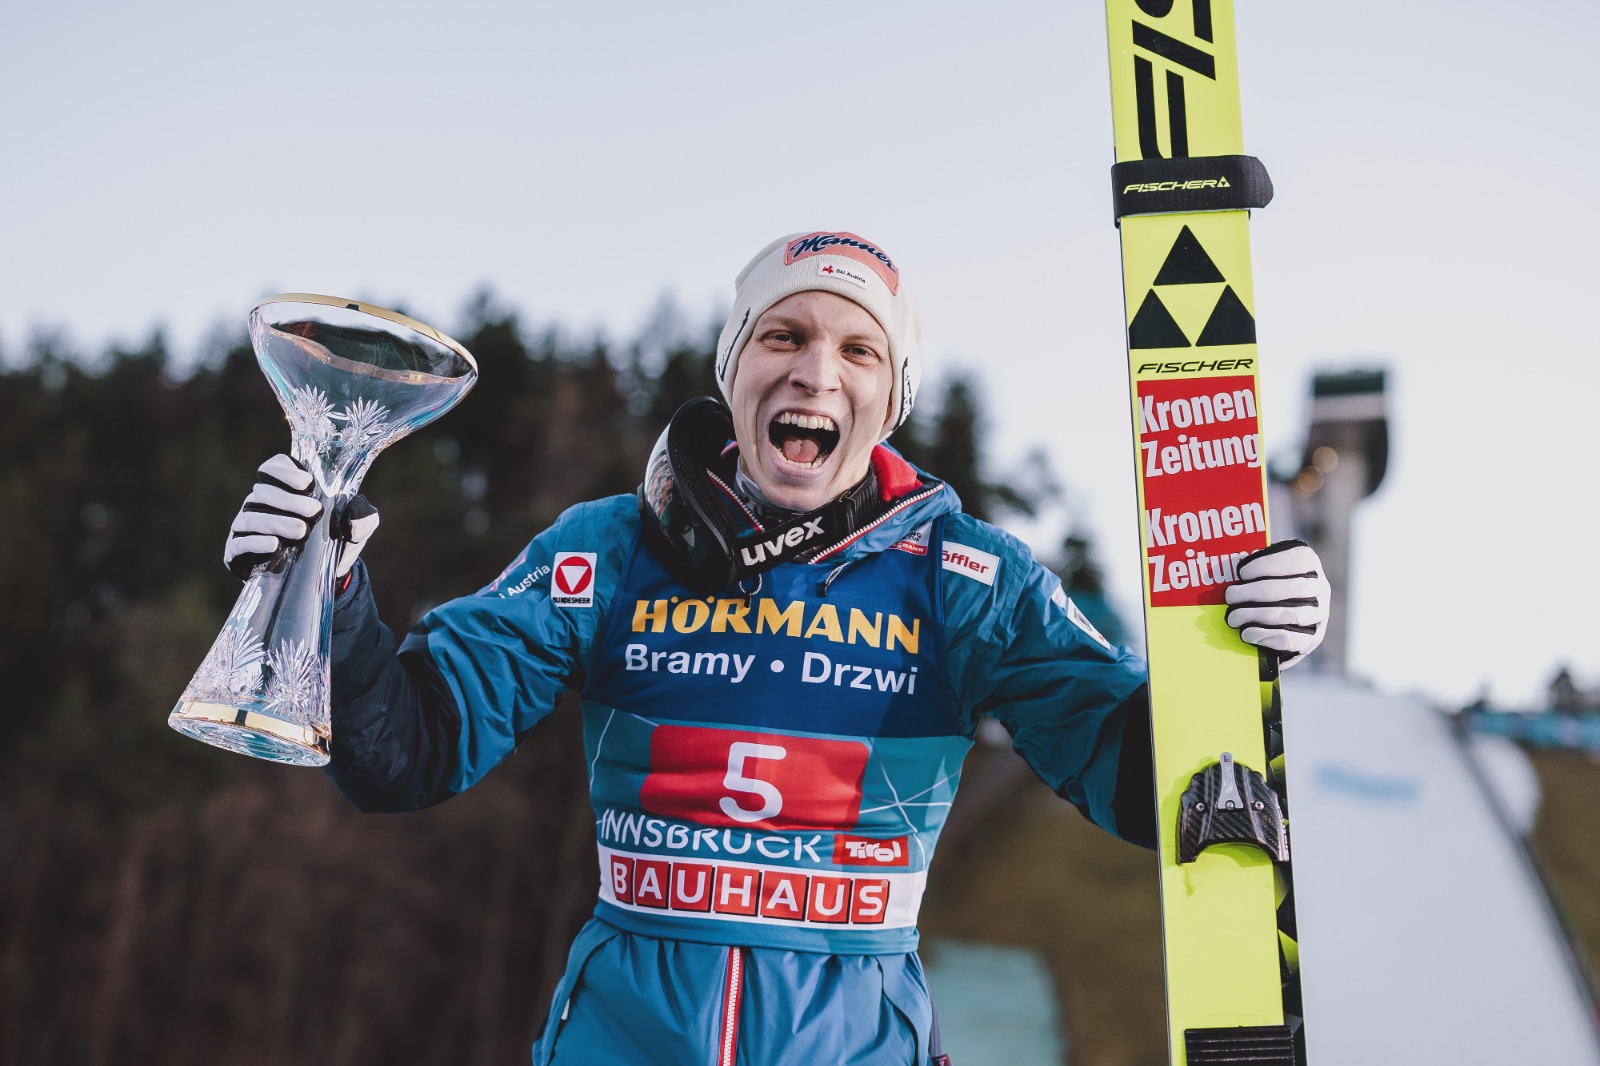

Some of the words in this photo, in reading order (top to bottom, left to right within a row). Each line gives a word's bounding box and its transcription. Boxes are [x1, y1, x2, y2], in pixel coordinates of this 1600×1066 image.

[1123, 180, 1217, 194] FISCHER
[789, 234, 897, 274] Manner
[1137, 358, 1254, 374] FISCHER
[1138, 388, 1258, 434] Kronen
[1141, 433, 1262, 478] Zeitung
[741, 516, 825, 567] uvex
[1145, 502, 1266, 549] Kronen
[507, 565, 551, 597] Austria
[942, 550, 989, 574] öffler
[631, 595, 920, 654] HÖRMANN
[625, 643, 756, 684] Bramy
[801, 651, 918, 695] Drzwi
[719, 741, 787, 823] 5
[600, 808, 821, 863] INNSBRUCK
[845, 840, 902, 862] Tirol
[611, 861, 883, 917] BAUHAUS
